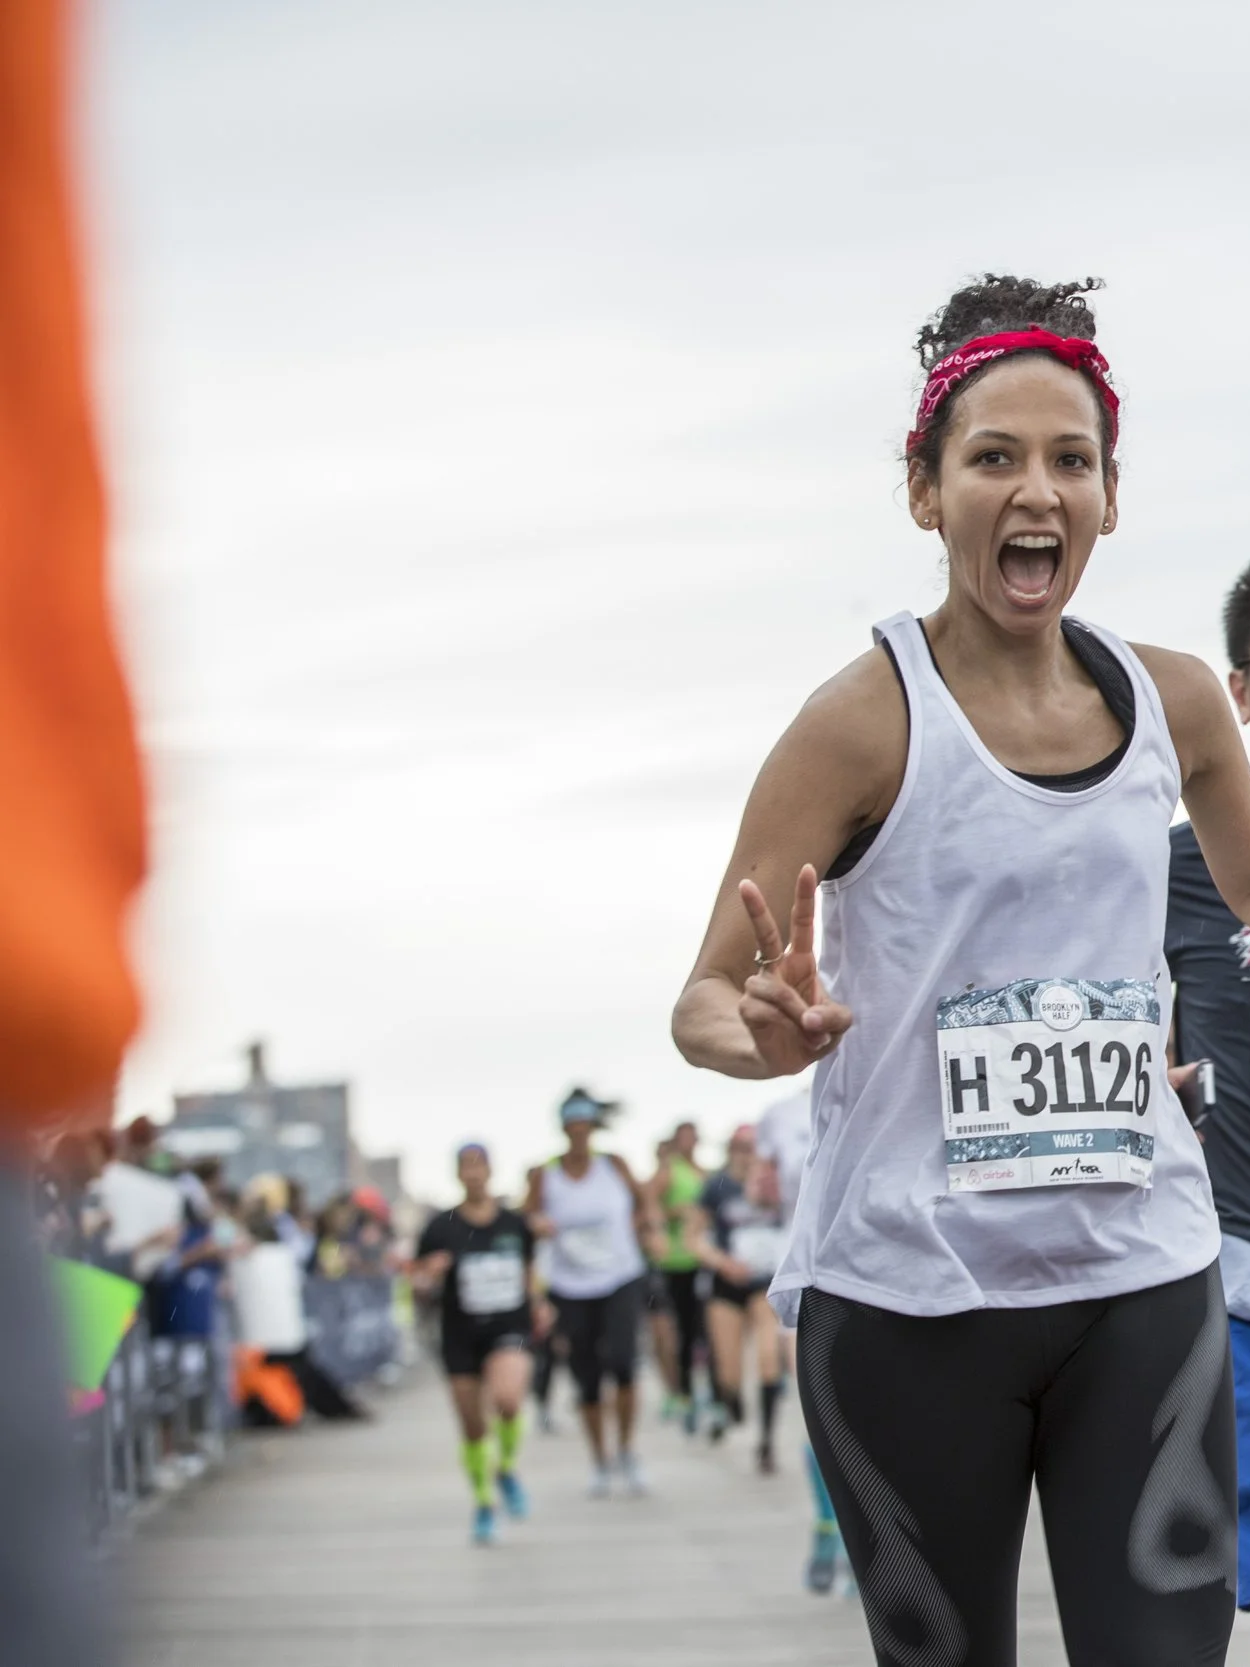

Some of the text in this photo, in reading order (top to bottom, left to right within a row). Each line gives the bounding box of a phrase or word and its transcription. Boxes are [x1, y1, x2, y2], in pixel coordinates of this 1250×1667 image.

[1041, 1003, 1080, 1012] BROOKLYN
[1052, 1011, 1071, 1020] HALF
[949, 1056, 990, 1114] H
[1010, 1041, 1152, 1117] 31126
[1052, 1132, 1094, 1149] WAVE 2
[983, 1169, 1014, 1180] airbnb
